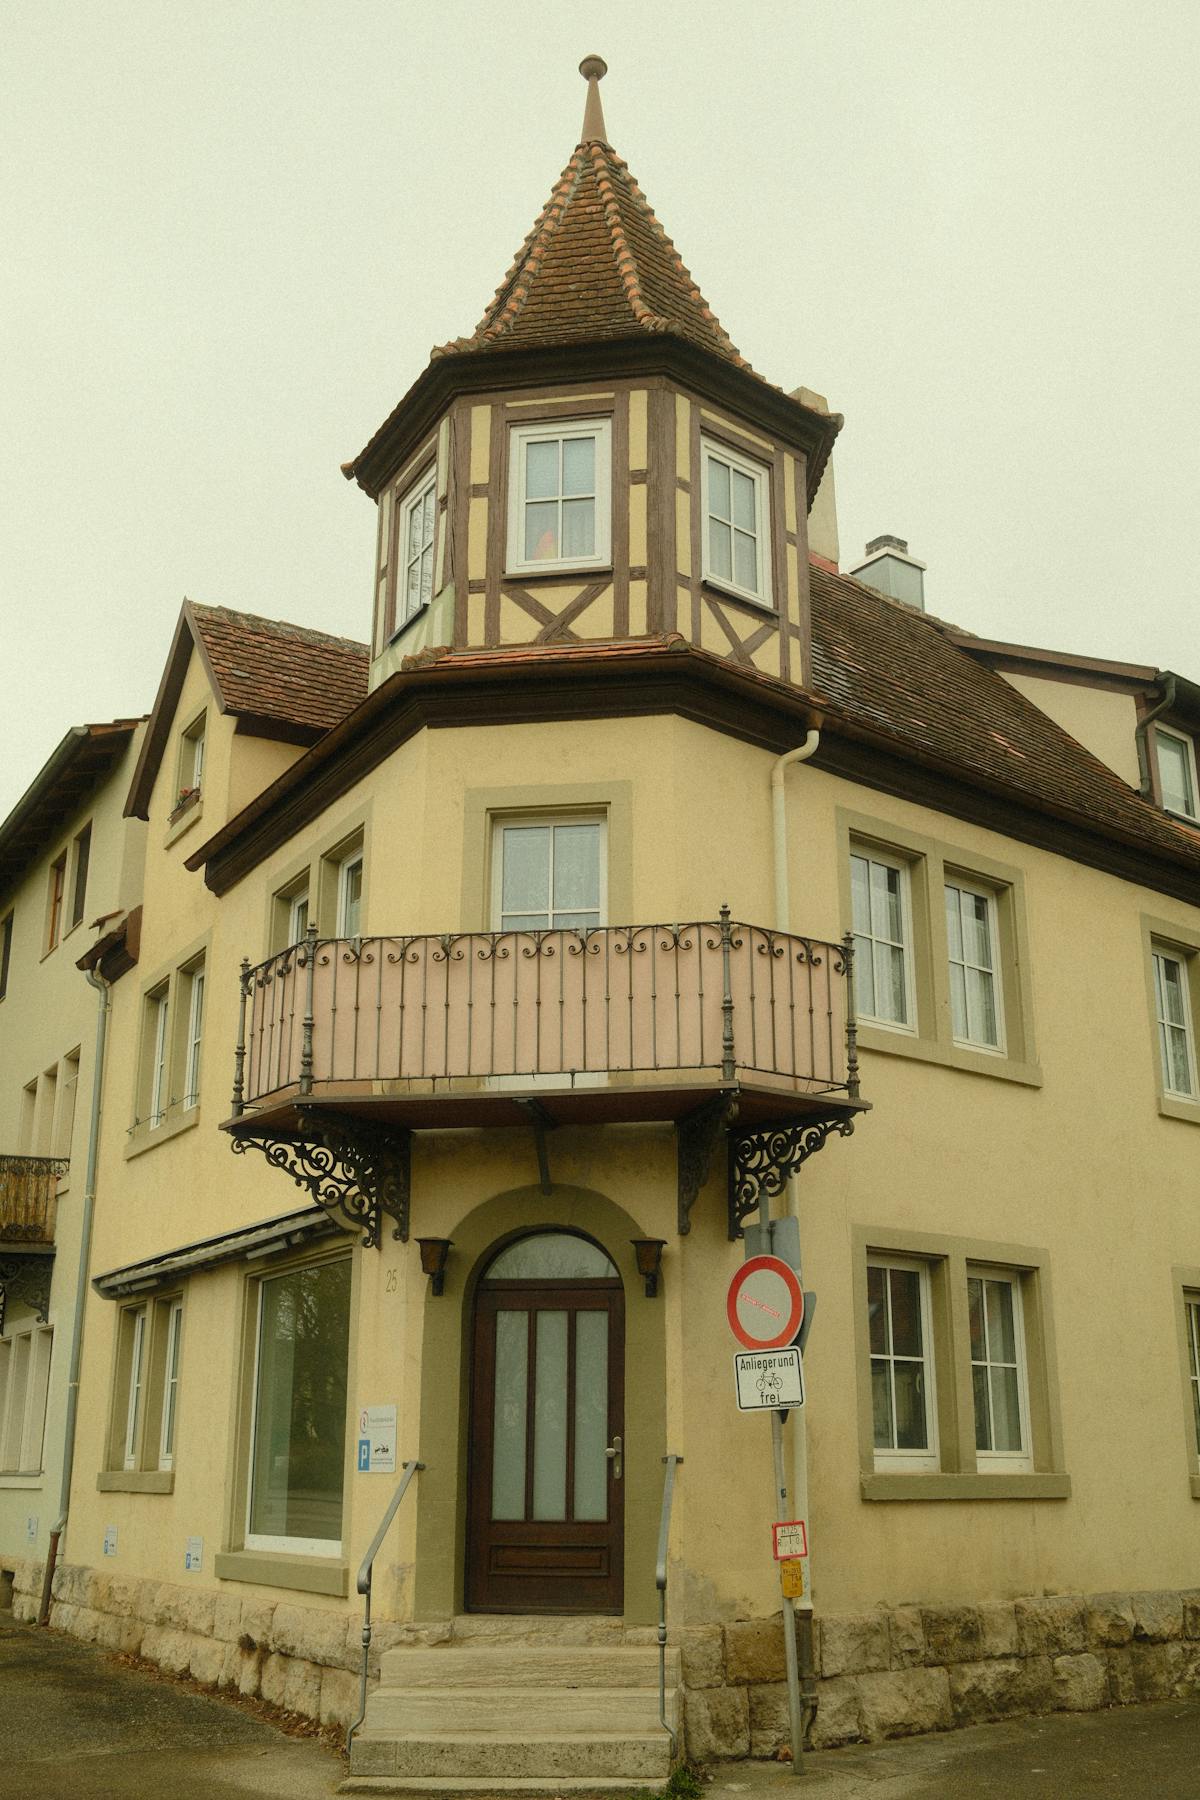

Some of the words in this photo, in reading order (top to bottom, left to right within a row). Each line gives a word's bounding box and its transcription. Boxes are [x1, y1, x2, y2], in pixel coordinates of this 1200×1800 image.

[386, 1269, 398, 1292] 25
[740, 1356, 776, 1371] Anlieger
[778, 1353, 794, 1367] und
[760, 1389, 780, 1404] frei
